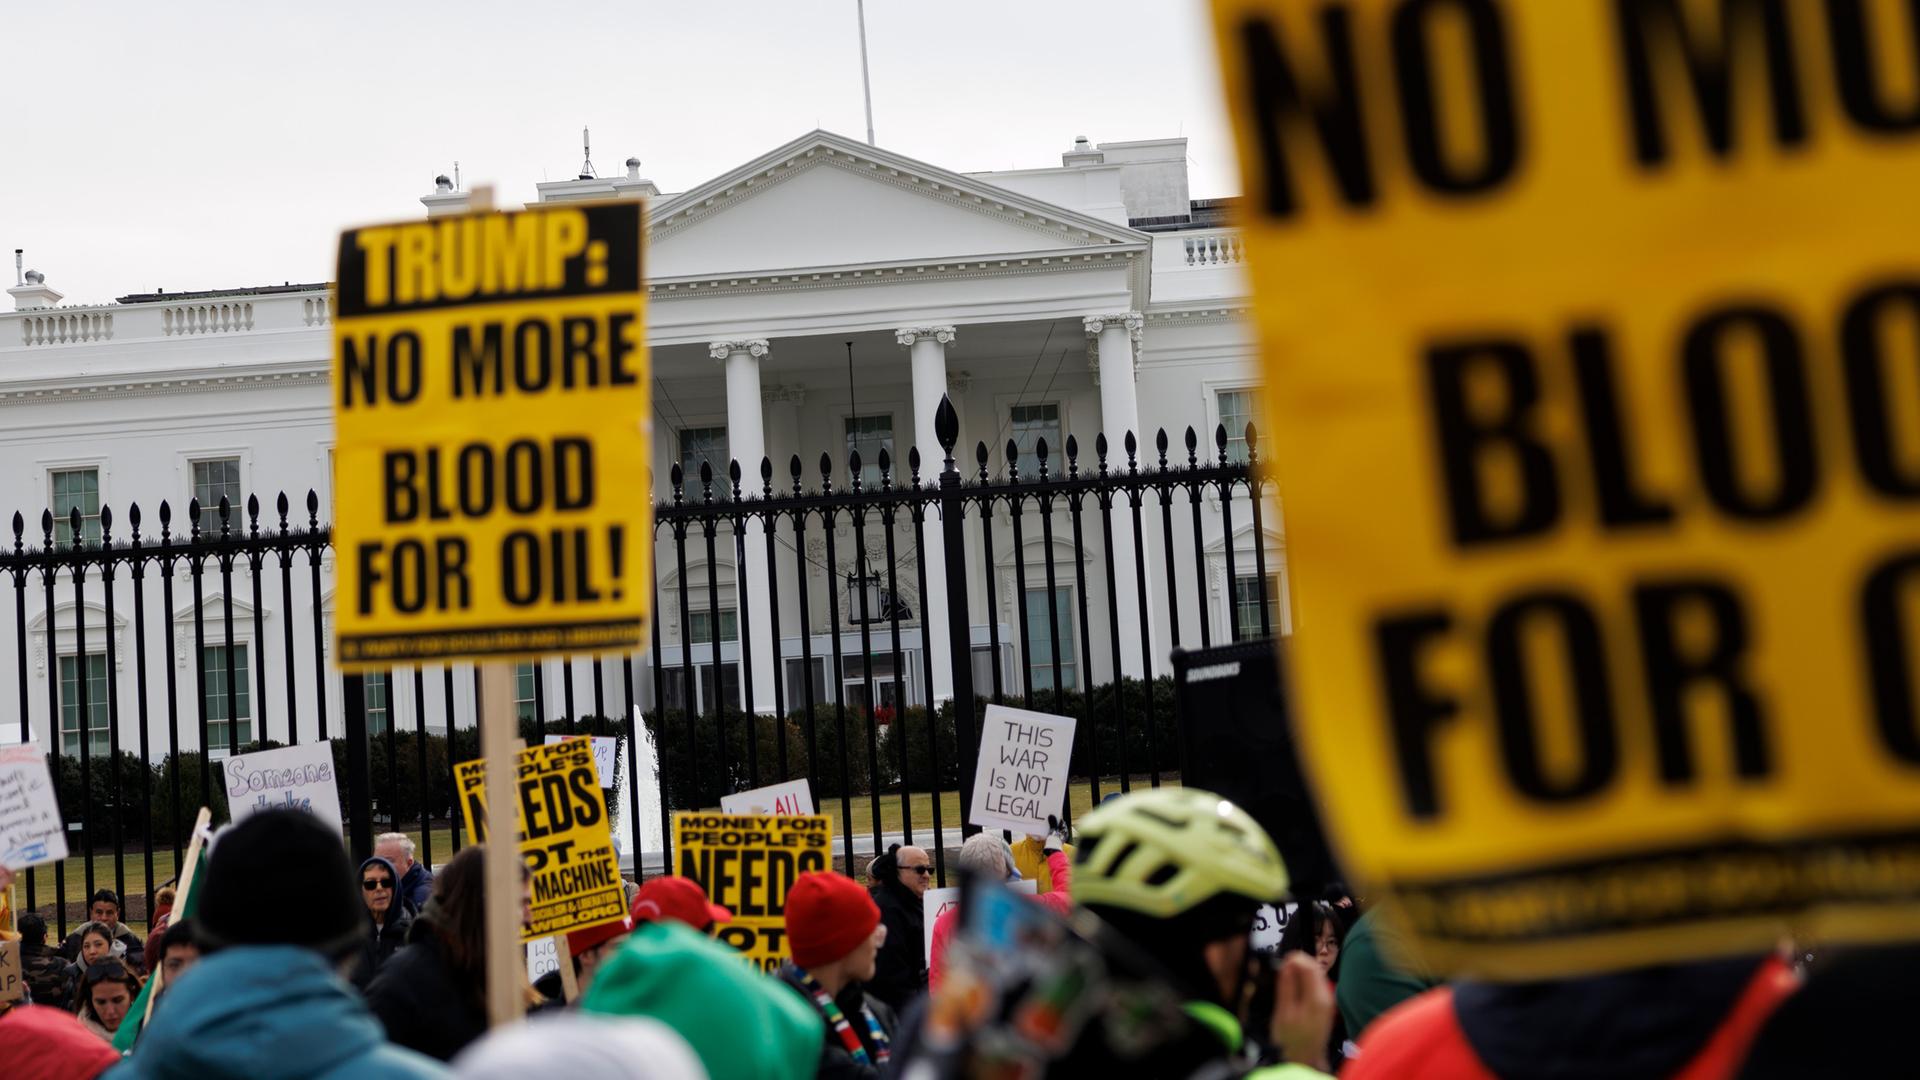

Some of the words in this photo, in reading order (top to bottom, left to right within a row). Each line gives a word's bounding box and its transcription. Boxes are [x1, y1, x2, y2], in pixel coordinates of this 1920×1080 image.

[1236, 0, 1524, 221] NO
[1612, 0, 1920, 172] MO
[357, 210, 608, 306] TRUMP:
[342, 332, 422, 408] NO
[451, 311, 639, 400] MORE
[1424, 278, 1920, 551] BLOO
[384, 437, 594, 525] BLOOD
[357, 535, 470, 617] FOR
[502, 525, 625, 608] OIL!
[1374, 573, 1775, 822] FOR
[543, 739, 588, 759] FOR
[1004, 721, 1054, 748] THIS
[1000, 745, 1049, 772] WAR
[227, 758, 332, 798] Someone
[1015, 772, 1053, 796] NOT
[681, 816, 771, 830] MONEY
[777, 817, 827, 831] FOR
[985, 792, 1046, 821] LEGAL
[577, 846, 611, 861] THE
[681, 832, 827, 847] PEOPLE'S
[533, 858, 617, 904] MACHINE
[716, 926, 786, 953] OT
